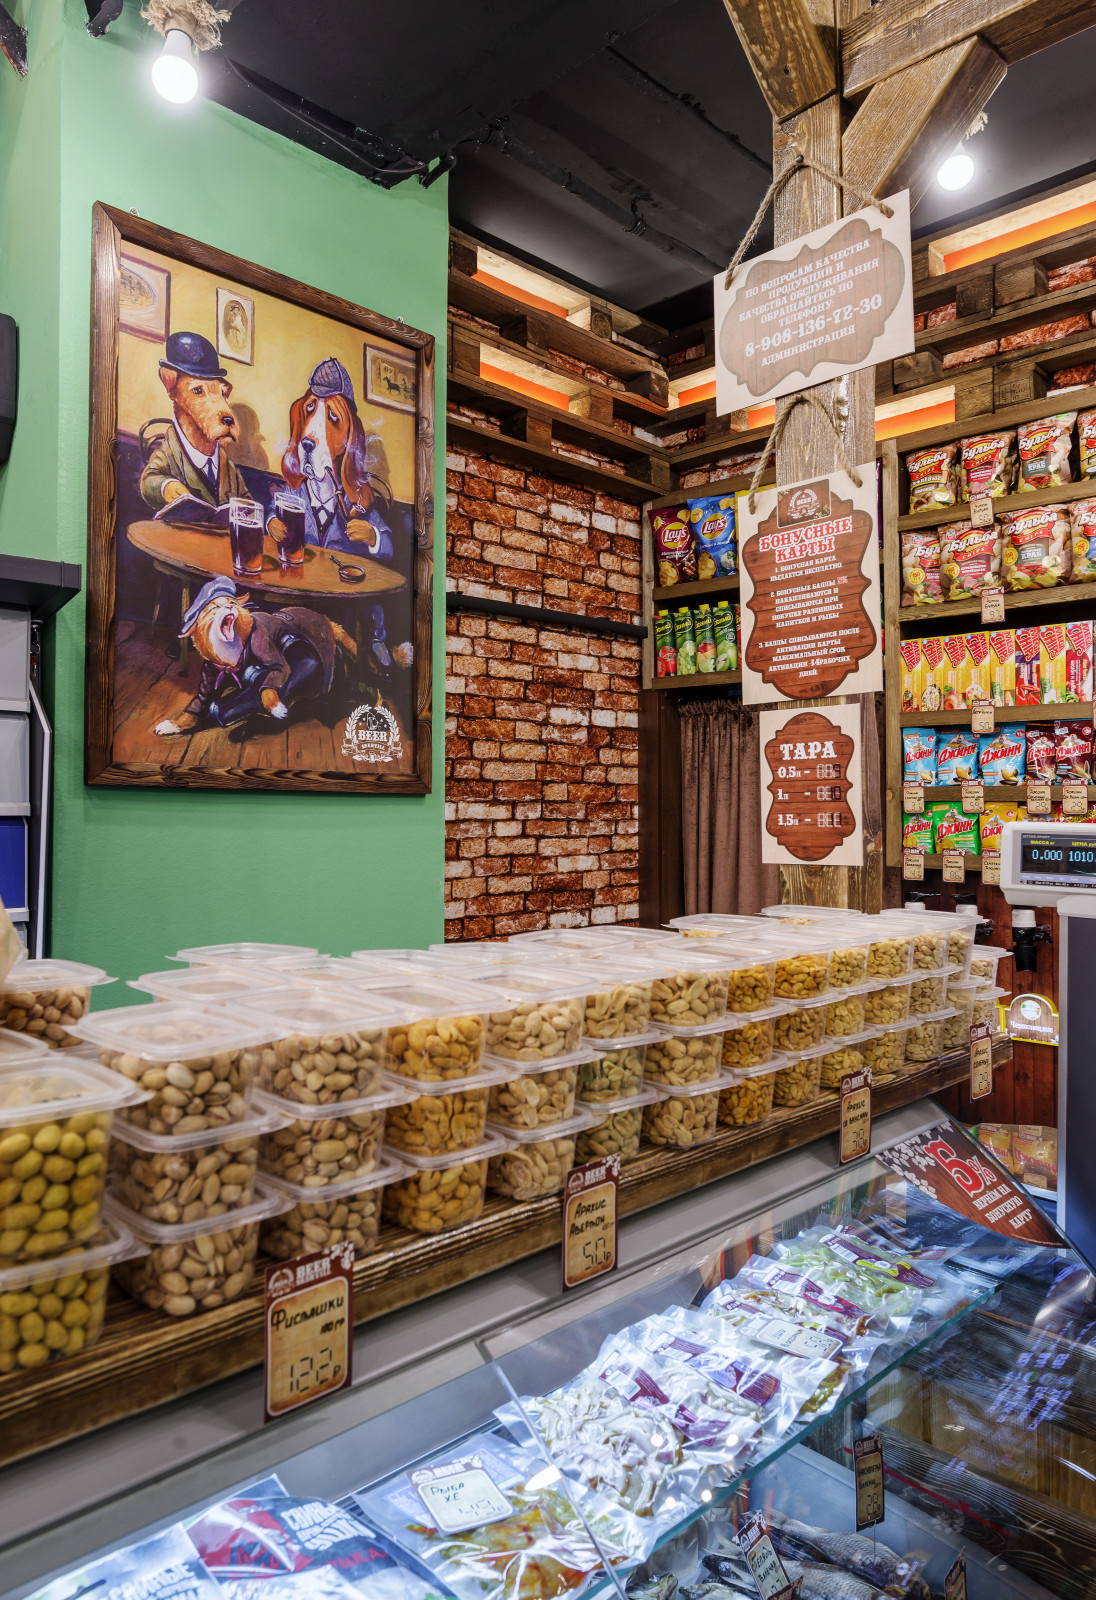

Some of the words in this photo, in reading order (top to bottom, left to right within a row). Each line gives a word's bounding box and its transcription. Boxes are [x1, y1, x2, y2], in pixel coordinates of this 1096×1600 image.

[745, 287, 759, 299] ПО
[761, 263, 812, 295] ВОПРОСАМ
[815, 239, 871, 269] КАЧЕСТВА
[739, 296, 788, 322] КАЧЕСТВА
[790, 258, 880, 301] ОБСЛУЖИВАНИЯ
[768, 267, 834, 300] ПРОДУКЦИИ
[835, 261, 845, 271] И
[761, 288, 836, 324] ОБРАЩАЙТЕСЬ
[838, 280, 854, 292] ПО
[745, 293, 882, 358] 8-908-136-72-30
[761, 324, 856, 367] АДМИНИСТРАЦИЯ
[1019, 426, 1061, 450] Бульба
[961, 438, 1005, 460] Бульба
[909, 451, 947, 473] Бульба
[703, 516, 727, 533] Lay's
[1008, 511, 1058, 535] Бульба
[664, 527, 687, 543] Lay's
[759, 515, 853, 552] БОНУСНЫЕ
[949, 531, 998, 552] Бульба
[775, 537, 836, 563] КАРТЫ
[914, 546, 940, 558] Бул
[780, 560, 814, 572] БОНУСНАЯ
[815, 555, 837, 564] КАРТА
[804, 562, 843, 575] БЕСПЛАТНО
[775, 588, 832, 604] НАКАПЛИВАЮТСЯ
[776, 584, 811, 597] БОНУСНЫЕ
[812, 580, 836, 590] БАЛЛЫ
[771, 610, 802, 621] ПОКУПКЕ
[802, 603, 843, 616] РАЗЛИЧНЫХ
[775, 599, 823, 612] СПИСЫВАЮТСЯ
[824, 596, 839, 604] ПРИ
[776, 617, 811, 628] НАПИТКОВ
[818, 612, 840, 621] РЫБЫ
[764, 638, 787, 648] БАЛЛЫ
[788, 631, 838, 644] СПИСЫВАЮТСЯ
[838, 627, 860, 636] ПОСЛЕ
[776, 642, 816, 654] АКТИВАЦИИ
[817, 639, 841, 647] КАРТЫ
[772, 648, 828, 662] МАКСИМАЛЬНЫЙ
[829, 646, 846, 654] СРОК
[768, 661, 808, 672] АКТИВАЦИИ
[799, 668, 818, 678] ДНЕЙ
[358, 729, 387, 741] BEER
[780, 741, 837, 760] ТАРА
[905, 749, 933, 765] ДЖИНН
[938, 743, 978, 767] ДЖИНН
[980, 743, 1023, 768] ДЖИНН
[1056, 742, 1091, 762] ДЖИНН
[903, 821, 931, 836] ДЖИНН
[937, 819, 974, 841] ДЖИНН
[981, 820, 1004, 839] ДЖИ
[1032, 849, 1063, 861] 0.000
[585, 1165, 606, 1181] BEER
[924, 1135, 998, 1198] 5%
[972, 1189, 1003, 1211] ВЕРНЁМ
[995, 1183, 1012, 1197] НА
[984, 1195, 1023, 1224] БОНУСНУЮ
[296, 1257, 331, 1281] BEER
